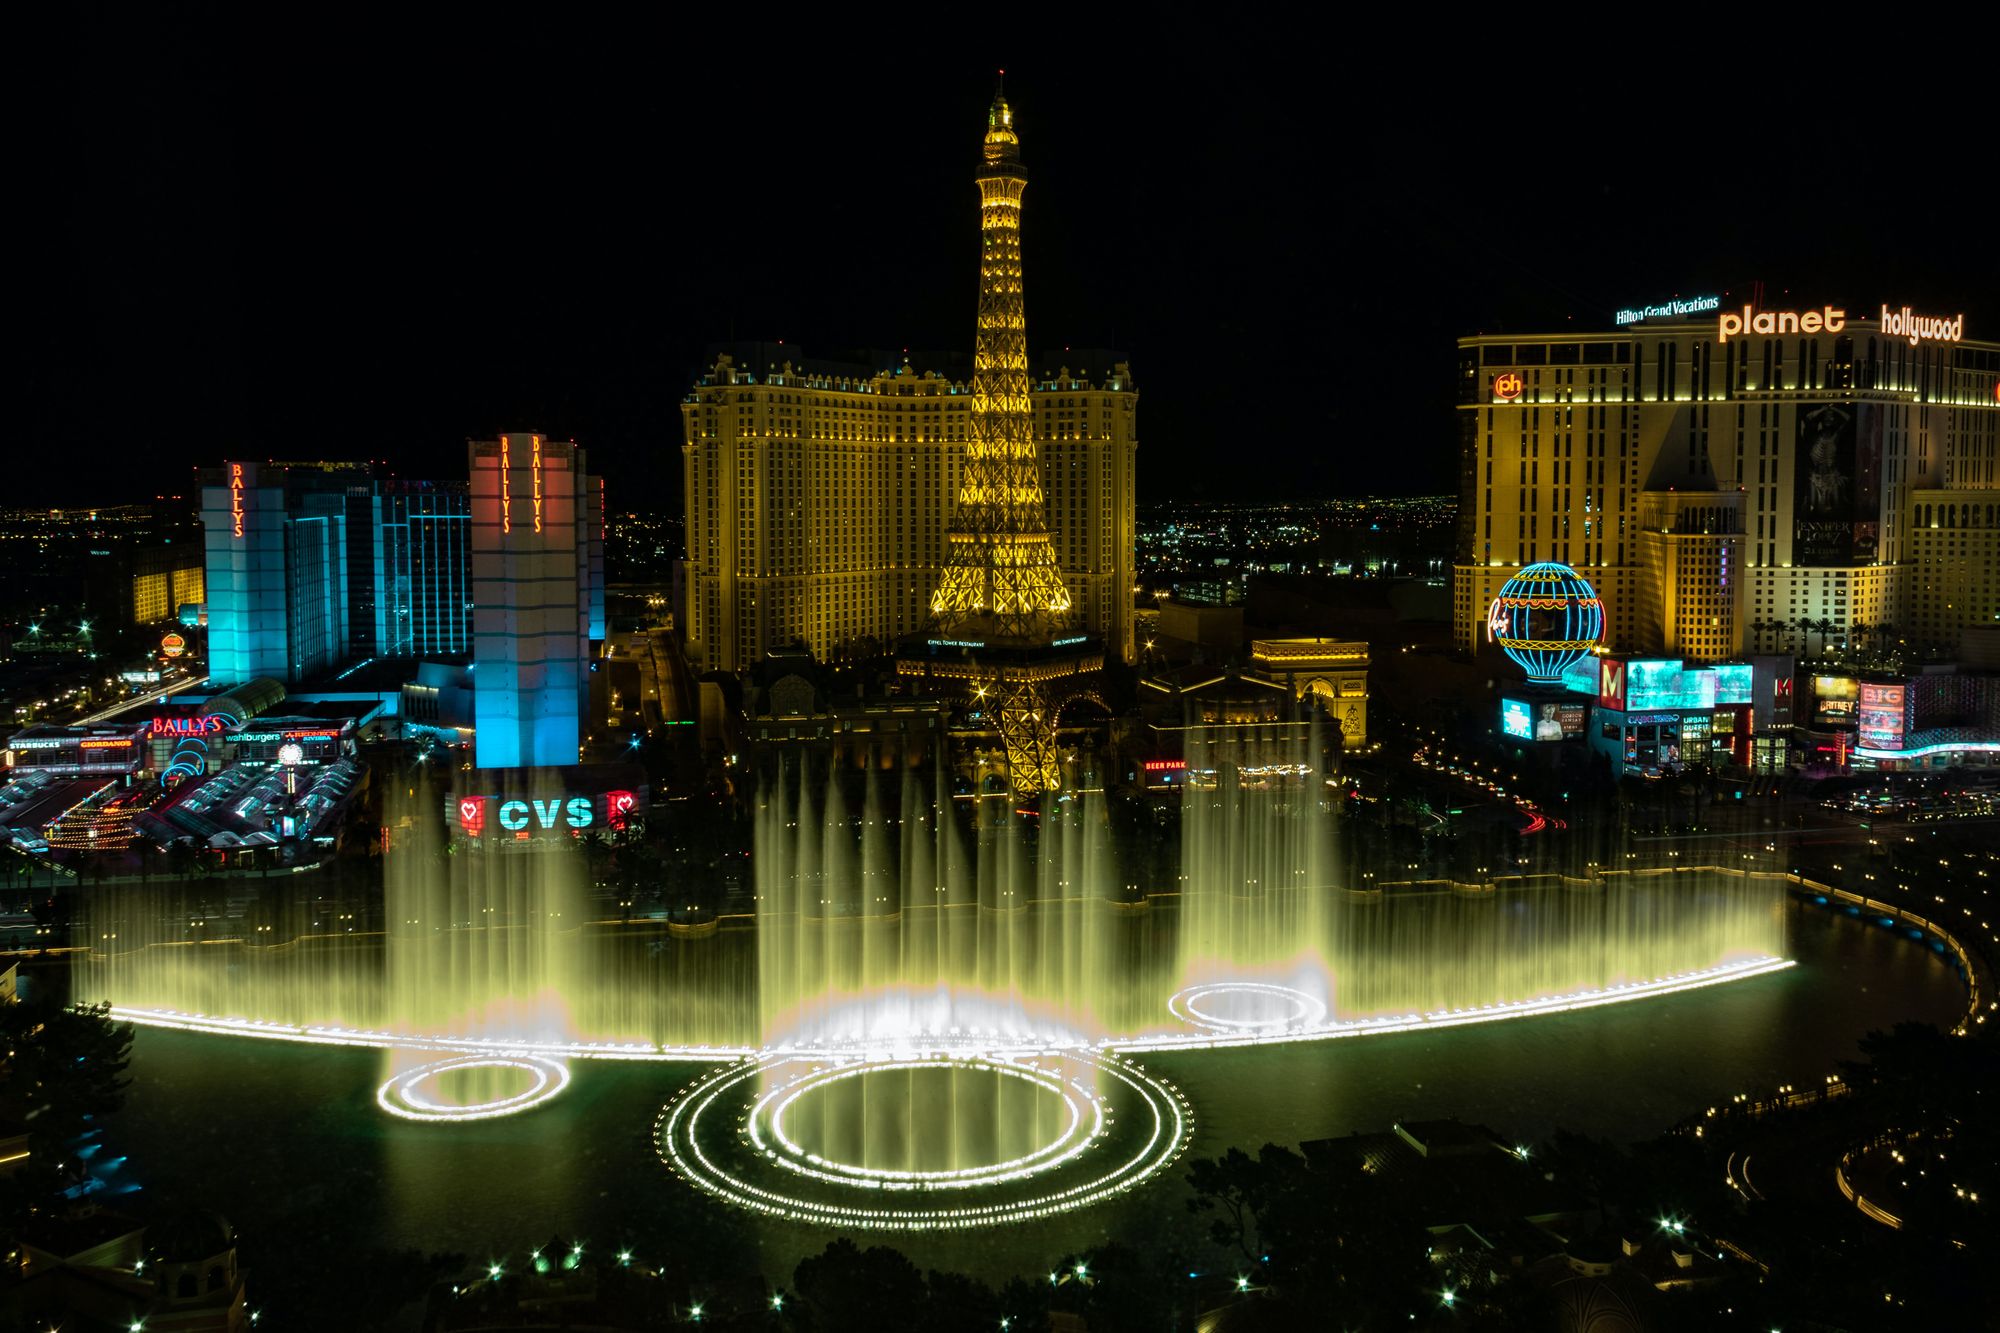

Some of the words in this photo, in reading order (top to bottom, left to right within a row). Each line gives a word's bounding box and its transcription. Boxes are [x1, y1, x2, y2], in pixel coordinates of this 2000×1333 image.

[1616, 309, 1643, 325] Hilton
[1644, 302, 1672, 317] Grand
[1673, 296, 1719, 315] Vacations
[1719, 305, 1846, 343] planet
[1881, 304, 1963, 346] hollywood
[1499, 374, 1521, 394] ph
[501, 436, 510, 534] BALLYS
[532, 435, 541, 533] BALLYS
[231, 463, 244, 537] BALLYS
[1603, 664, 1622, 699] M
[1863, 688, 1902, 705] BIG
[1683, 716, 1708, 724] URBAN
[1820, 700, 1854, 712] BRITNEY
[153, 717, 221, 733] BALLY'S
[226, 733, 280, 742] wahlburgers
[500, 798, 593, 830] CVS
